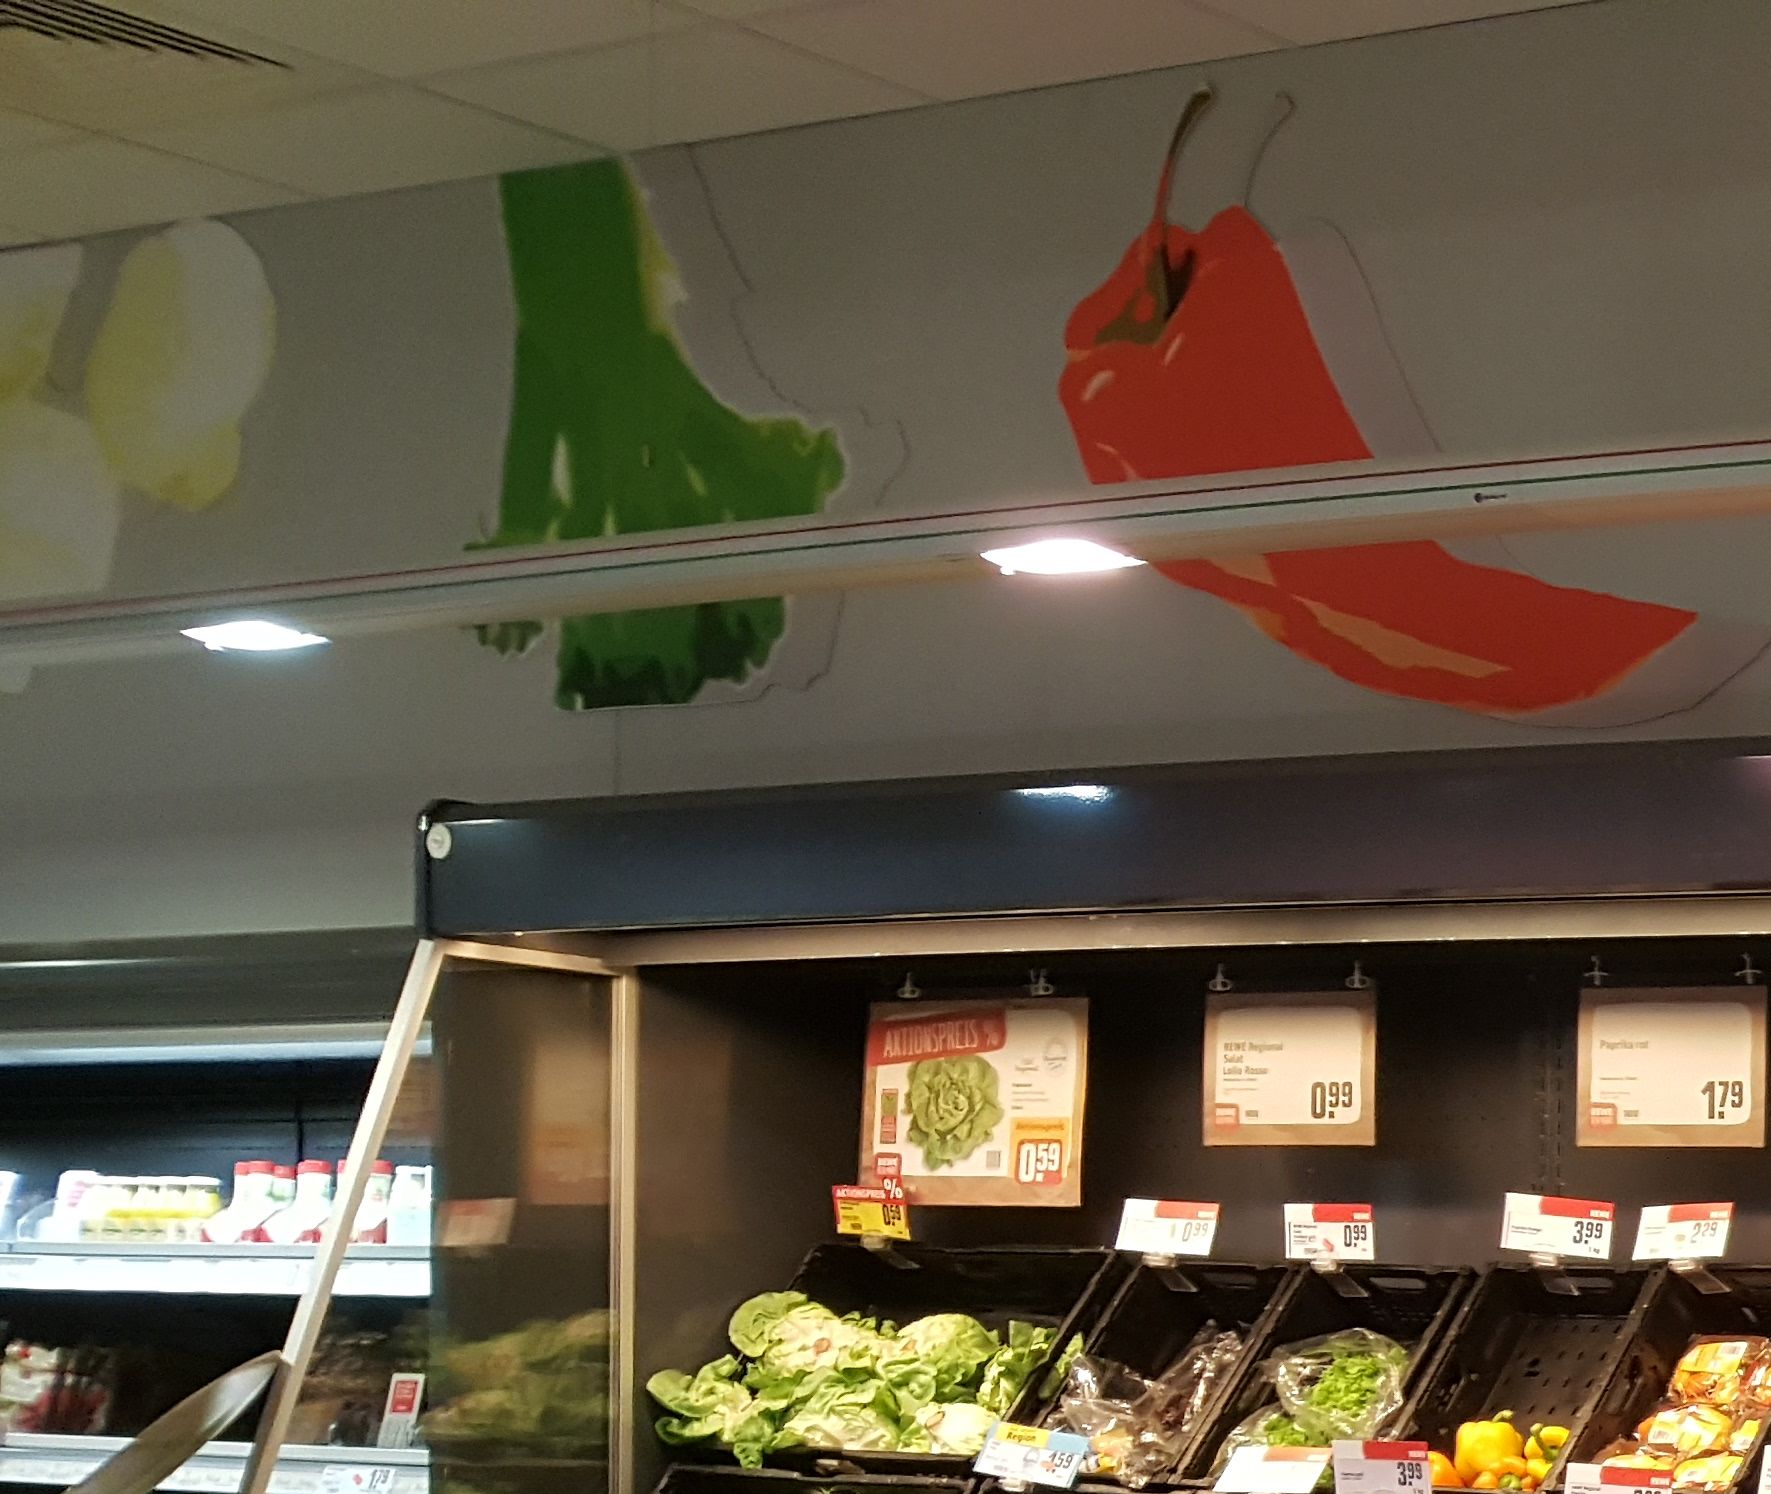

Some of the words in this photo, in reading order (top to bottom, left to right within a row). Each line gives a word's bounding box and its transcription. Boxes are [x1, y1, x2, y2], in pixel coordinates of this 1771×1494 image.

[883, 1019, 978, 1058] AKTIONSPREIS
[1600, 1040, 1634, 1051] Paprika
[1311, 1081, 1353, 1119] 0.99
[1701, 1081, 1743, 1119] 1.79
[1018, 1142, 1060, 1183] 0.59
[1343, 1224, 1368, 1248] 0.99
[1573, 1221, 1603, 1244] 3.99
[1006, 1431, 1036, 1444] Region
[1397, 1462, 1422, 1486] 3.99
